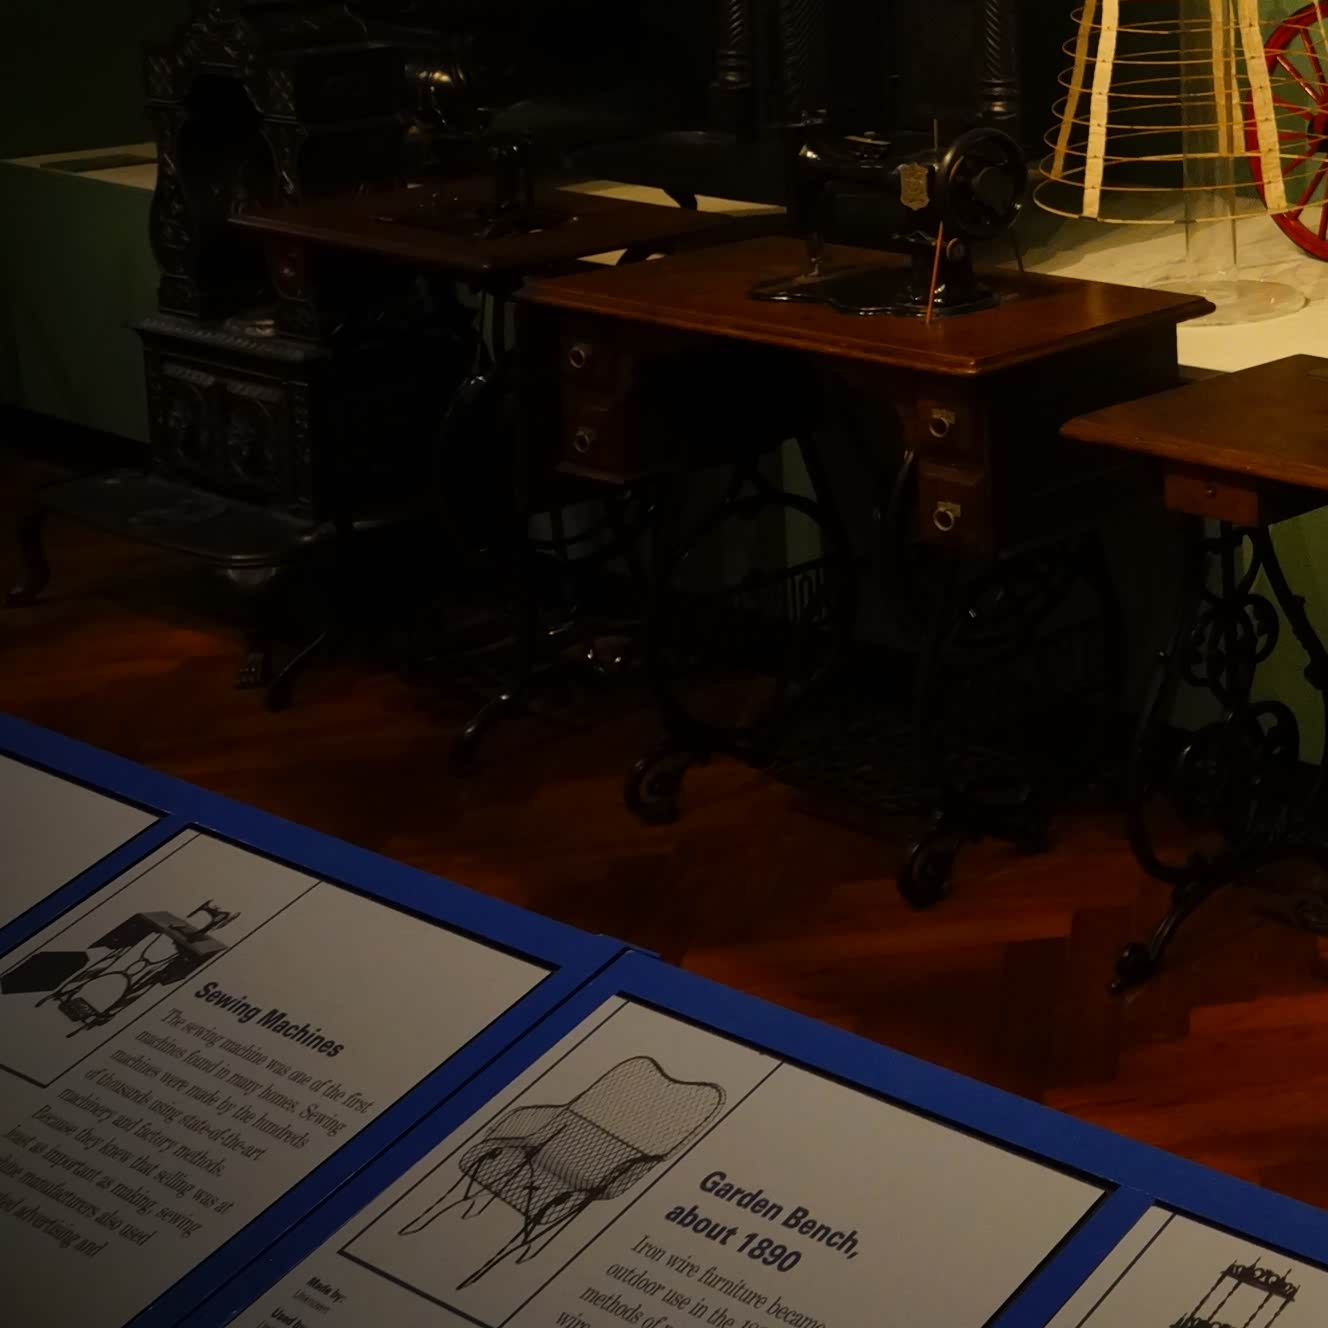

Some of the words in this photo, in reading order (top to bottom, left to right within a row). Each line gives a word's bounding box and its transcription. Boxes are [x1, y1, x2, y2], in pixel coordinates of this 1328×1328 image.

[194, 981, 263, 1024] Sewing
[255, 1008, 345, 1058] Machines
[160, 1007, 187, 1028] The
[180, 1022, 226, 1048] sewing
[218, 1038, 269, 1066] machine
[265, 1058, 292, 1077] was
[287, 1070, 313, 1086] one
[308, 1079, 334, 1093] of
[321, 1083, 346, 1102] the
[341, 1092, 375, 1114] first
[181, 1049, 225, 1074] found
[212, 1063, 231, 1080] in
[225, 1072, 264, 1097] many
[257, 1083, 300, 1113] homes.
[298, 1103, 348, 1137] Sewing
[56, 1087, 119, 1123] machinery
[111, 1114, 144, 1133] and
[133, 1122, 179, 1153] factory
[172, 1144, 226, 1178] methods.
[95, 1072, 153, 1105] thousands
[147, 1099, 184, 1125] using
[177, 1114, 268, 1161] state-of-the-art
[159, 1071, 189, 1092] were
[184, 1084, 221, 1107] made
[215, 1095, 238, 1116] by
[231, 1104, 257, 1124] the
[250, 1112, 310, 1149] hundreds
[41, 1145, 103, 1184] important
[95, 1175, 115, 1190] as
[109, 1183, 158, 1216] making,
[154, 1207, 203, 1239] sewing
[73, 1127, 105, 1151] they
[97, 1137, 135, 1164] knew
[128, 1154, 161, 1177] that
[153, 1169, 196, 1199] selling
[191, 1188, 220, 1209] was
[213, 1201, 235, 1215] at
[73, 1238, 110, 1258] and
[94, 1210, 124, 1231] also
[118, 1223, 158, 1247] used
[664, 1204, 739, 1246] about
[736, 1232, 802, 1273] 1890
[699, 1170, 784, 1221] Garden
[780, 1205, 859, 1260] Bench,
[579, 1287, 644, 1324] methods
[605, 1263, 666, 1297] outdoor
[661, 1288, 692, 1310] use
[687, 1297, 709, 1319] in
[706, 1308, 735, 1328] the
[630, 1234, 667, 1262] Iron
[665, 1254, 701, 1278] wire
[697, 1266, 768, 1310] furniture
